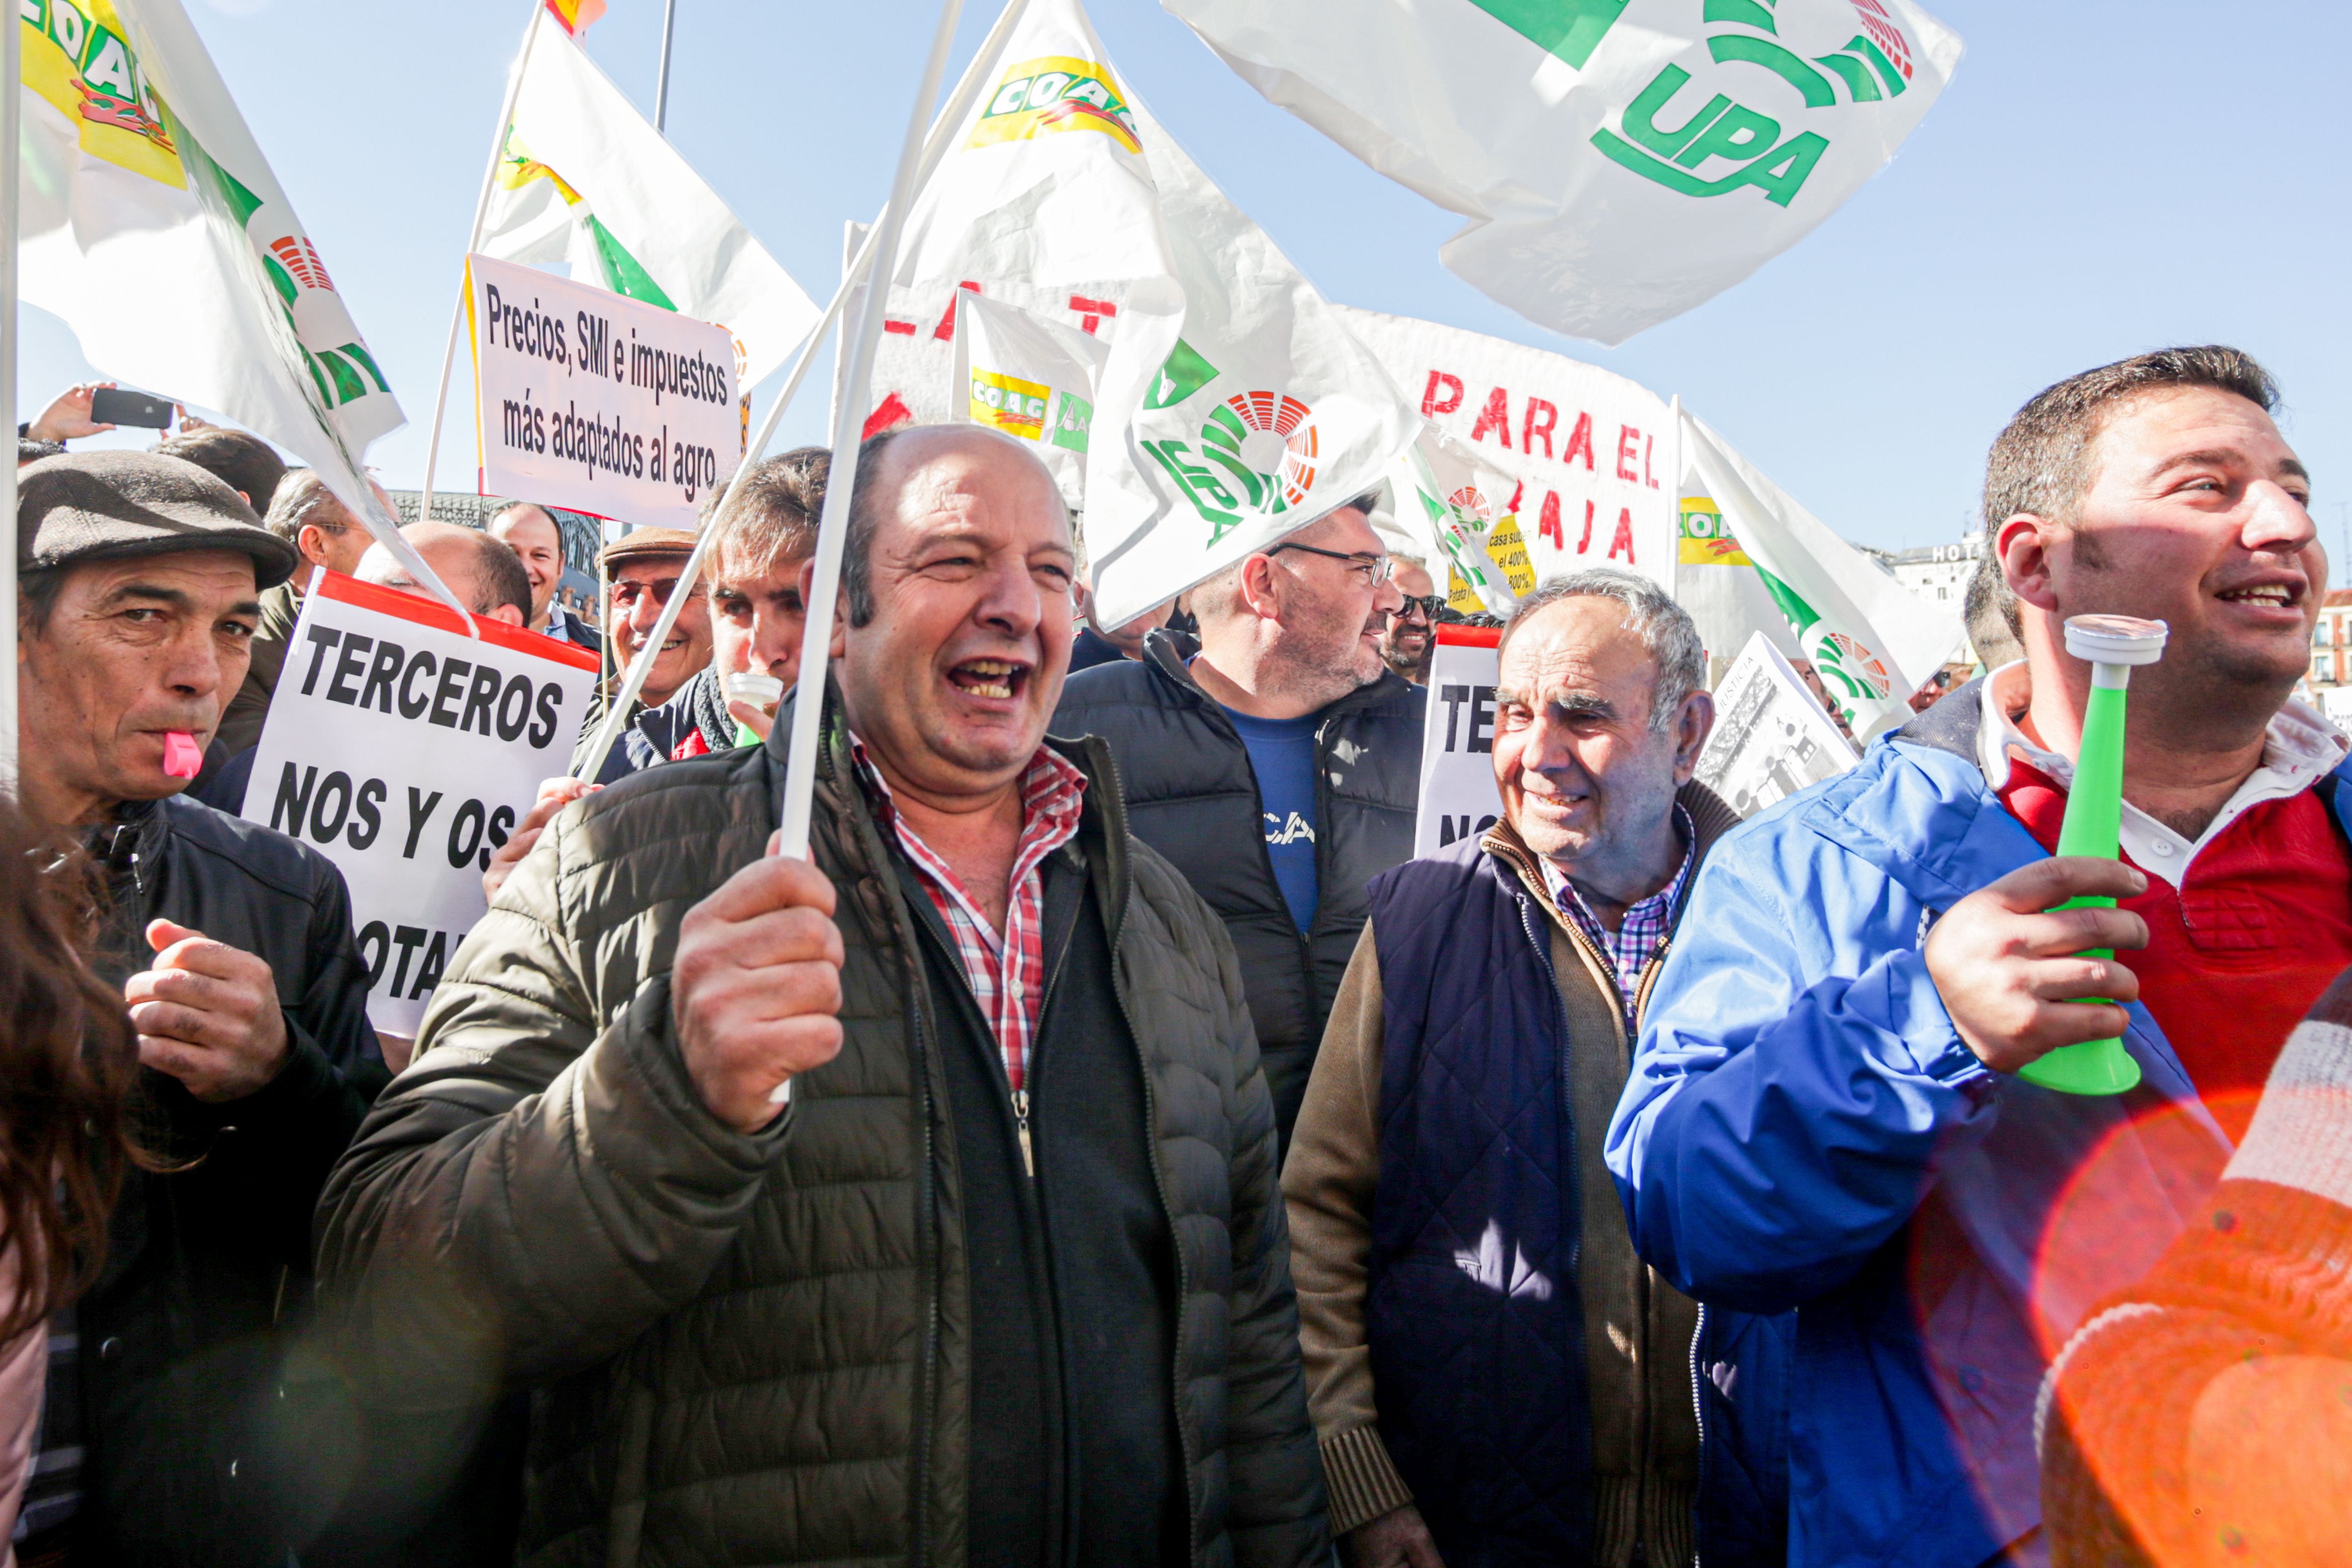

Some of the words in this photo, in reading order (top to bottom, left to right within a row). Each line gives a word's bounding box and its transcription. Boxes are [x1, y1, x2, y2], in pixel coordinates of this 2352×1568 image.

[1589, 62, 1830, 208] UPA
[486, 283, 572, 377] Precios,
[578, 310, 608, 379] SMI
[614, 339, 624, 383] e
[631, 328, 727, 406] impuestos
[503, 388, 545, 454] más
[552, 400, 644, 481] adaptados
[651, 425, 667, 483] al
[973, 380, 1045, 418] COAG
[1421, 369, 1594, 471] PARA
[1617, 424, 1660, 490] EL
[1139, 439, 1245, 551] UPA
[1489, 533, 1508, 547] casa
[1449, 586, 1466, 604] Patata
[1499, 553, 1506, 569] el
[300, 624, 563, 749] TERCEROS
[270, 761, 387, 851] NOS
[403, 785, 444, 860] Y
